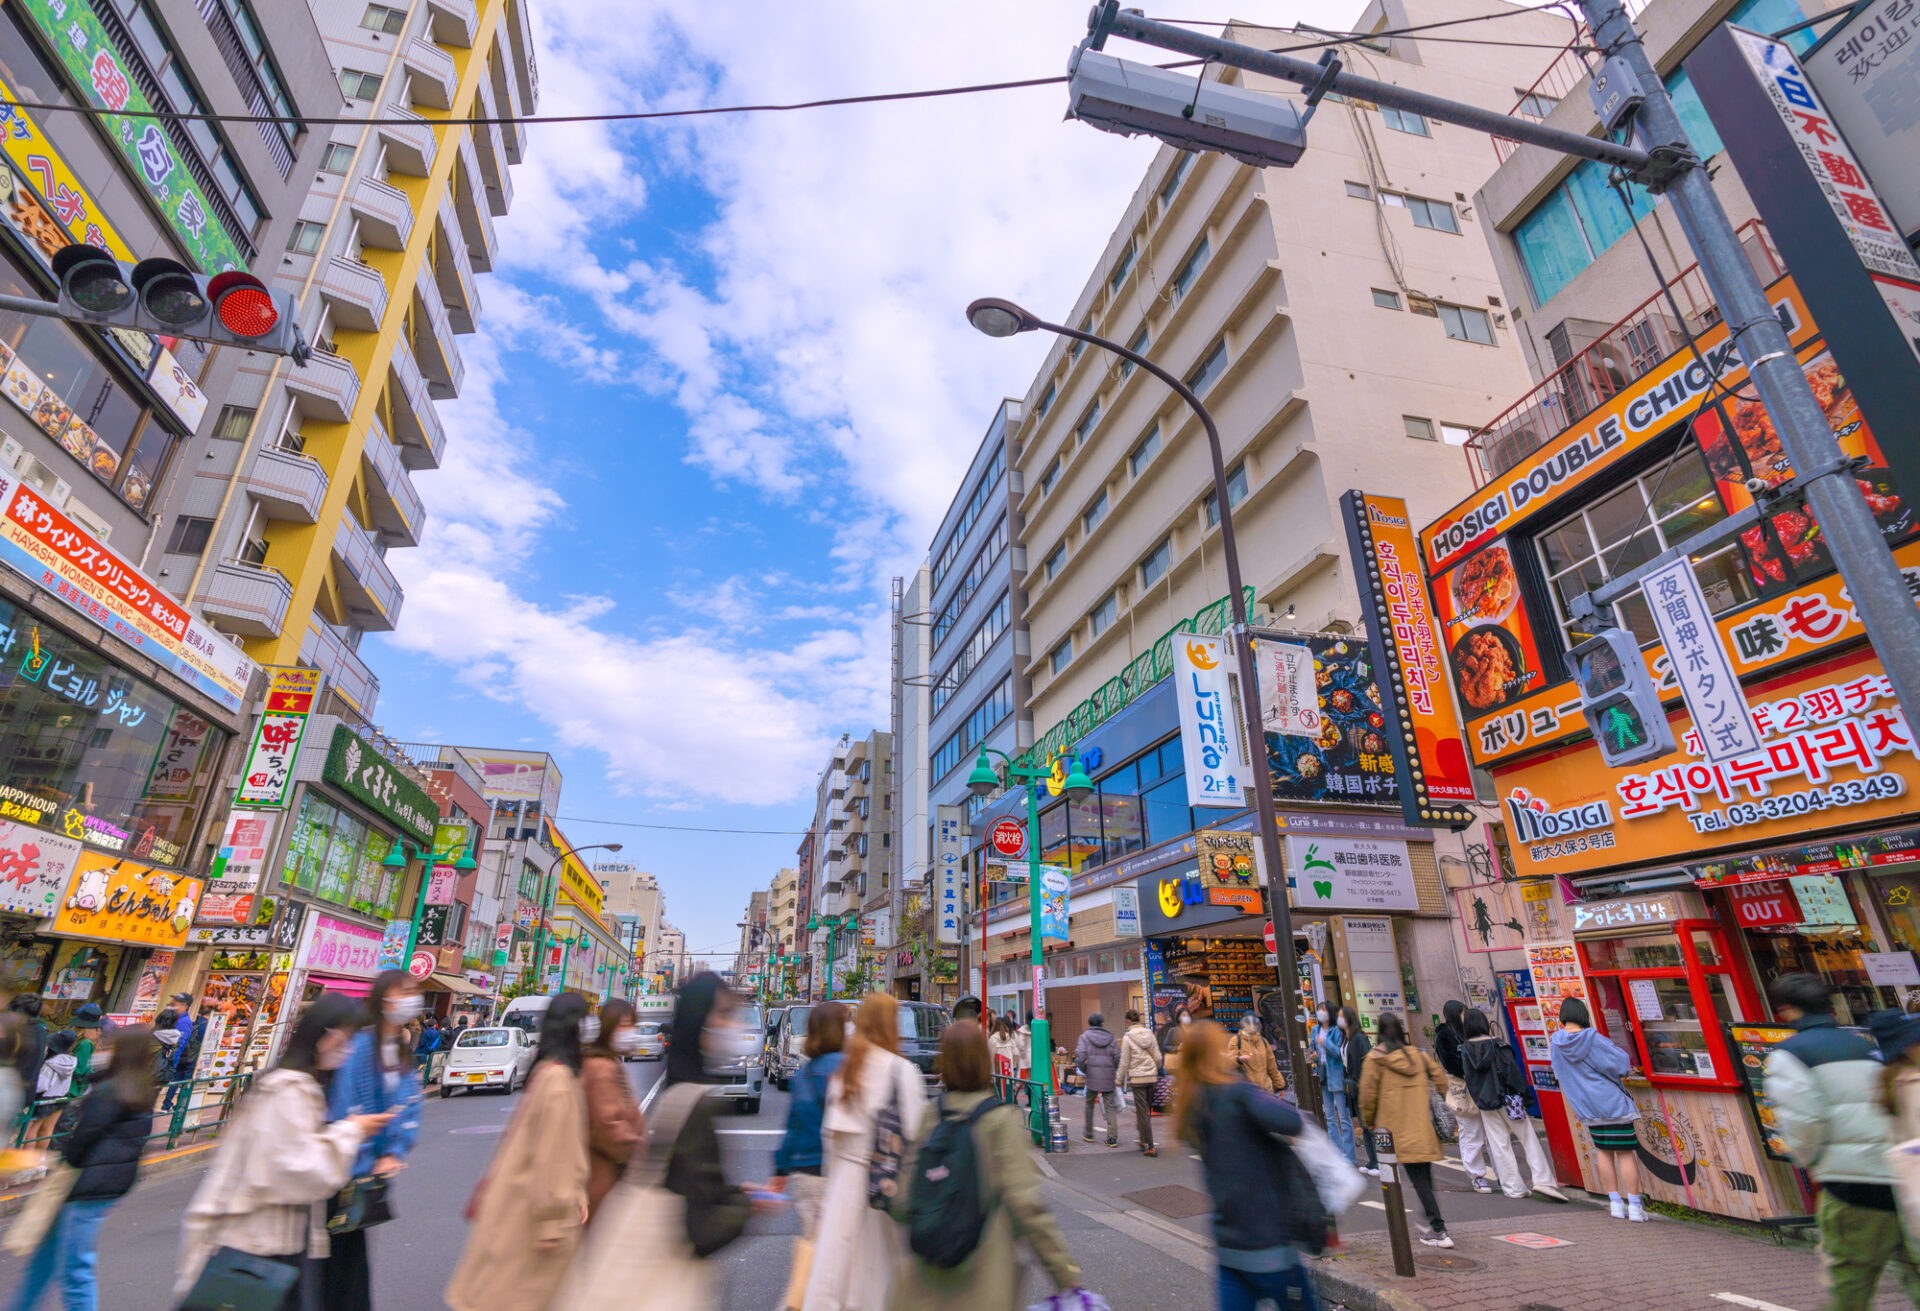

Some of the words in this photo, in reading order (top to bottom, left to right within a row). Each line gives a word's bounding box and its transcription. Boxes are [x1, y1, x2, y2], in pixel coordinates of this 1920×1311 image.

[1433, 495, 1508, 561] HOSIGI
[1513, 418, 1622, 511] DOUBLE
[10, 526, 58, 567] HAYASHI
[60, 563, 104, 601] WOMEN'S
[105, 592, 134, 621] CLINIC
[1377, 541, 1434, 715] 호식이두마리치킨
[1404, 572, 1440, 684] ホシギ2羽チキン
[185, 629, 215, 658] 産婦人科
[1656, 574, 1744, 753] 夜間押ボタン式
[48, 660, 99, 706] ビョル
[1273, 651, 1289, 728] ご通行願います
[1286, 652, 1300, 717] 立ち止まらず
[1359, 752, 1395, 774] 新感
[362, 765, 398, 807] くるむ
[1203, 774, 1226, 792] 2F
[1325, 772, 1398, 796] 韓国ポチ
[1, 801, 42, 825] 飲み放題
[31, 798, 58, 814] HOUR
[1689, 812, 1727, 832] Tel.
[1729, 774, 1900, 825] 03-3204-3349
[84, 815, 105, 832] OPEN
[995, 831, 1022, 846] 消火栓
[1530, 831, 1616, 861] 新大久保3号店
[1881, 841, 1915, 851] Alcohol
[1804, 852, 1835, 863] Alcohol
[1230, 894, 1253, 904] OPEN
[1731, 878, 1784, 900] TAKE
[1742, 900, 1783, 921] OUT
[198, 930, 212, 939] 2F
